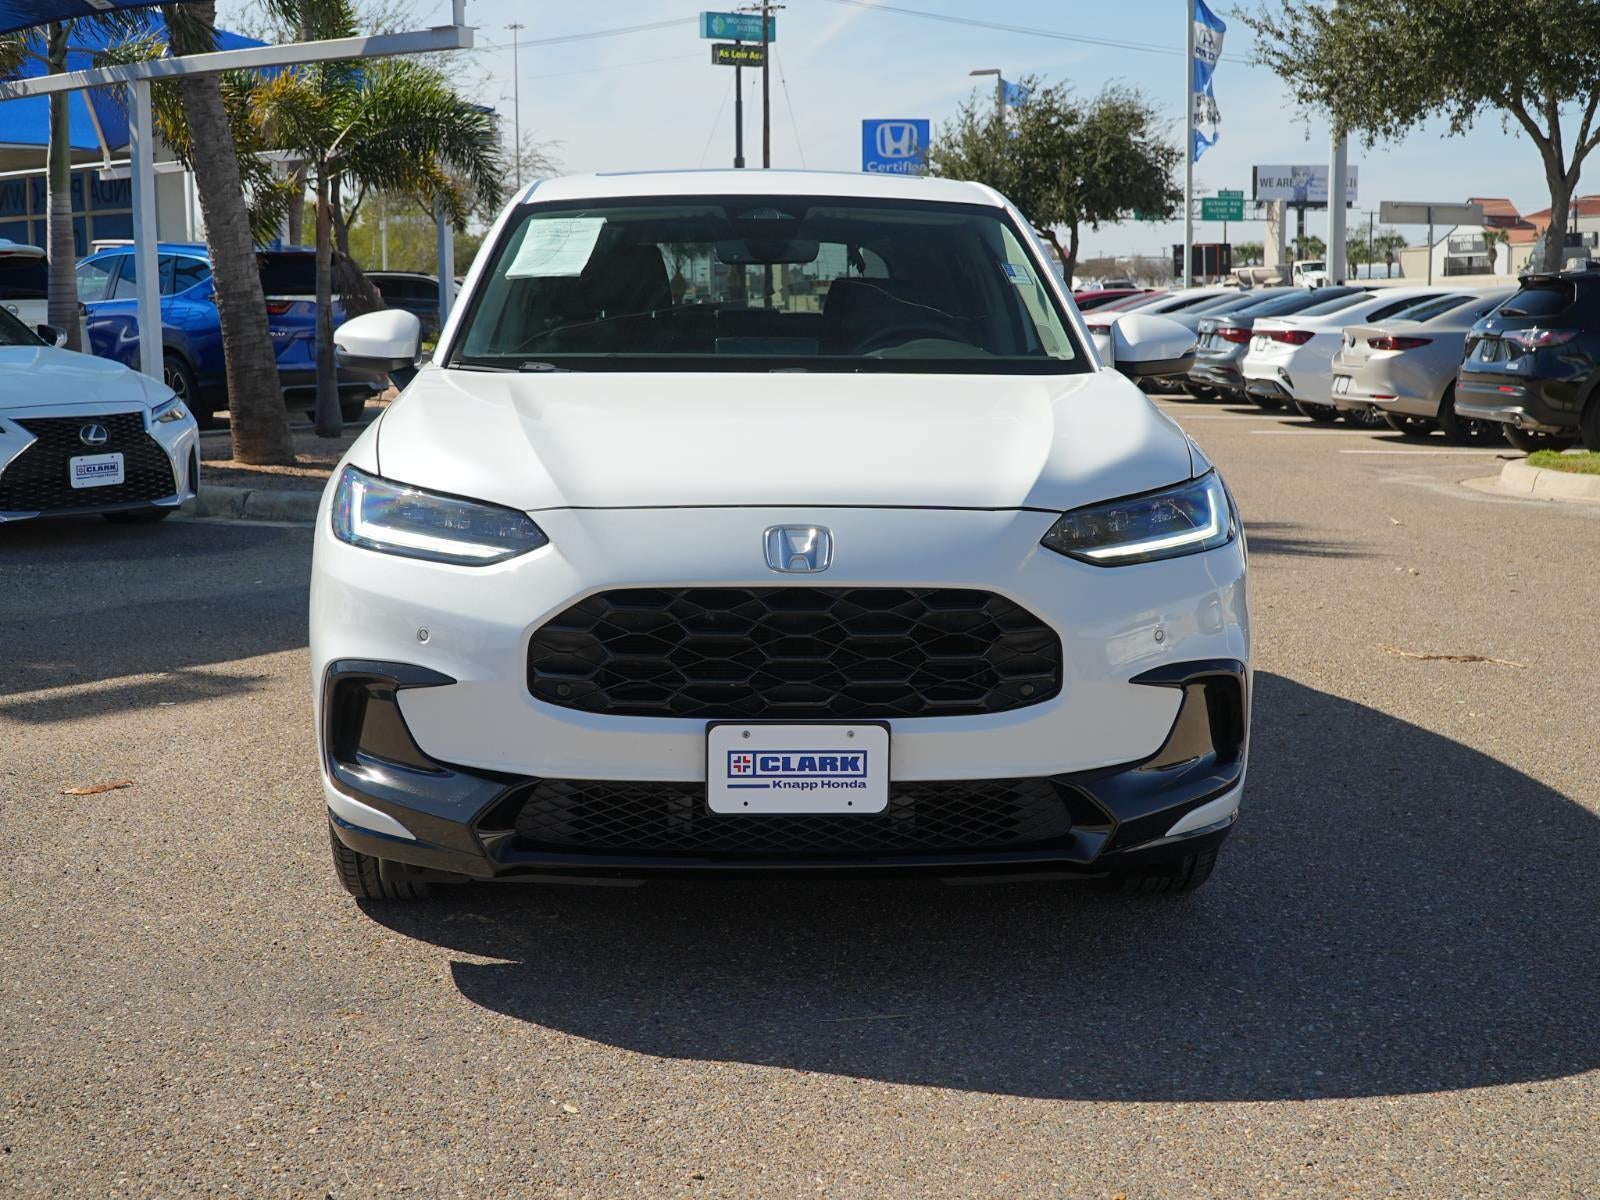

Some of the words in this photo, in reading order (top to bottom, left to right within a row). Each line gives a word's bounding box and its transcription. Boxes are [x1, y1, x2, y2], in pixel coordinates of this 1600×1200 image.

[720, 50, 729, 58] As
[731, 50, 748, 59] Low
[750, 51, 759, 60] As
[1260, 178, 1274, 188] WE
[1276, 178, 1295, 188] ARE
[86, 464, 116, 473] CLARK
[760, 756, 861, 772] CLARK
[772, 780, 819, 791] Knapp
[821, 780, 867, 789] Honda
